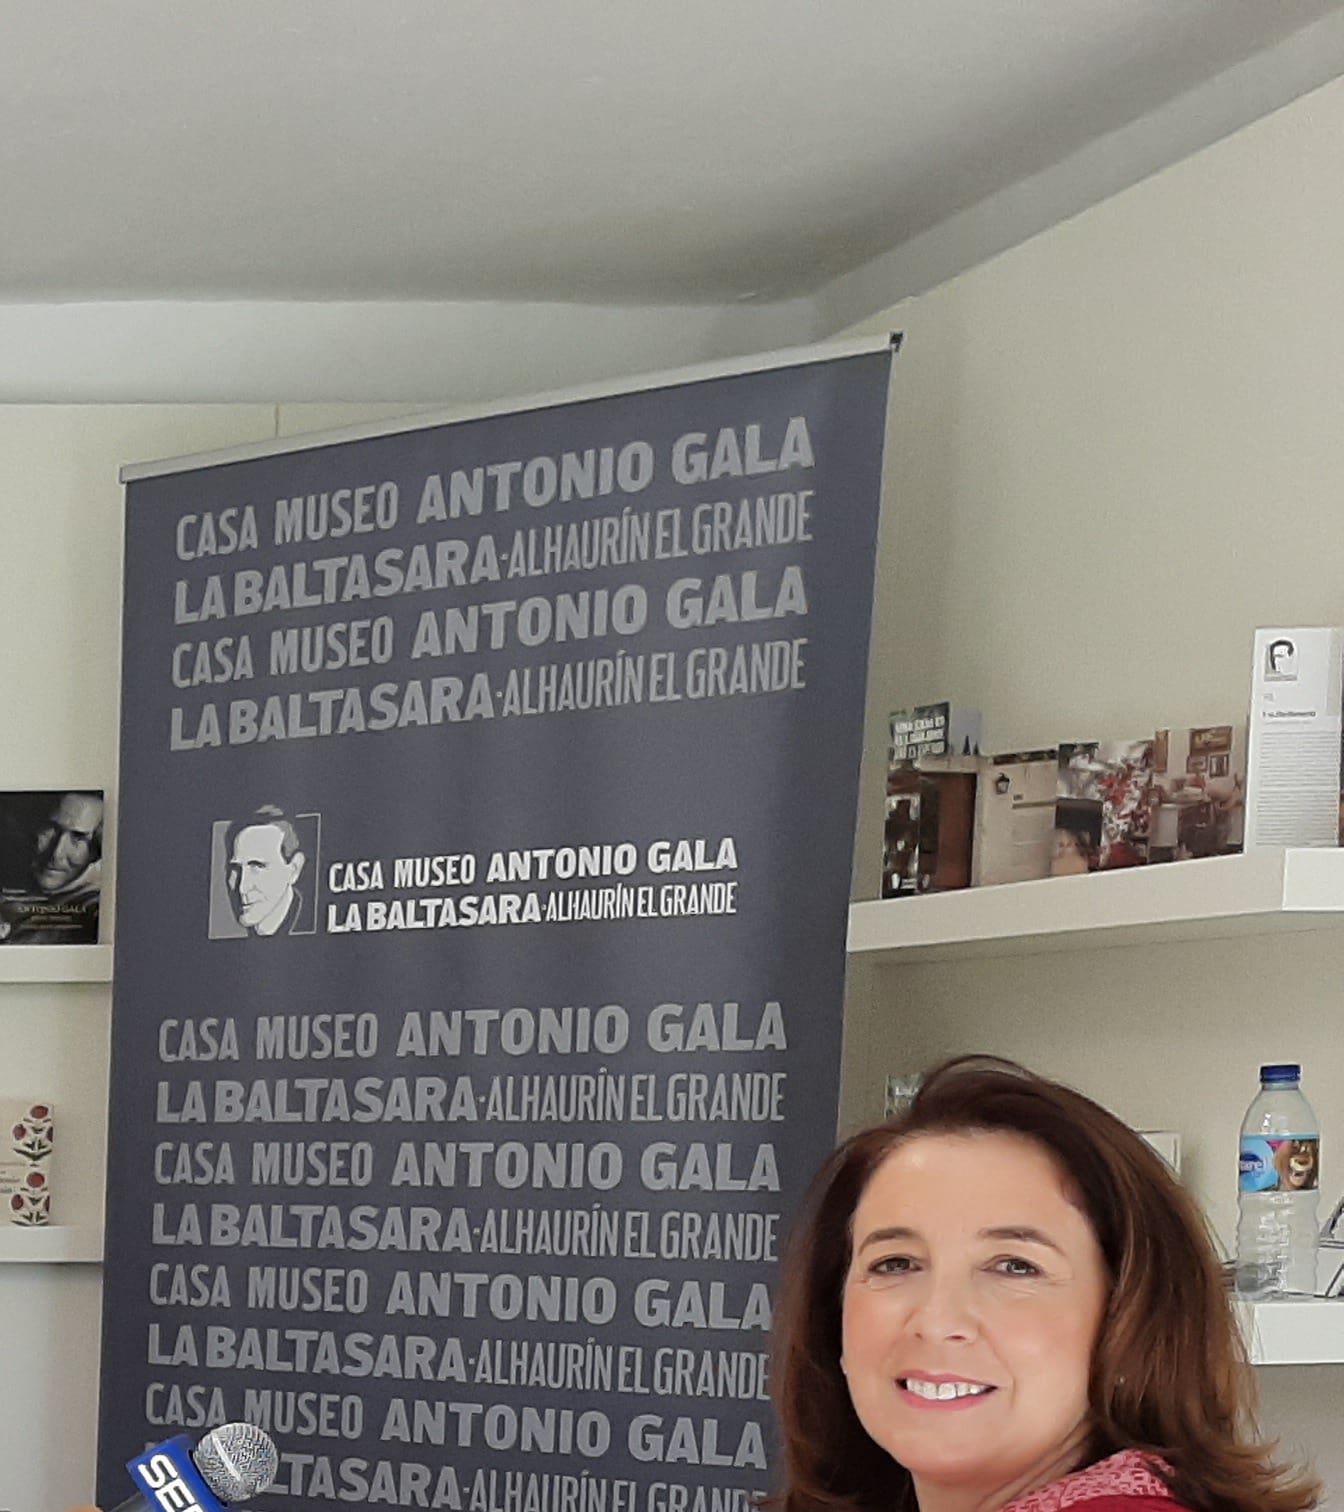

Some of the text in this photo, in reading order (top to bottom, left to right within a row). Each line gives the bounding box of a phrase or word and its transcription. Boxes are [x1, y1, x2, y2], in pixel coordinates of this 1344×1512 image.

[177, 416, 815, 560] CASA MUSEO ANTONIO GALA
[175, 576, 226, 624] LA
[655, 508, 688, 559] EL
[692, 490, 814, 554] GRANDE
[172, 566, 808, 688] CASA MUSEO ANTONIO GALA
[170, 704, 221, 751] LA
[649, 652, 682, 702] EL
[686, 638, 807, 699] GRANDE
[329, 838, 738, 893] CASA MUSEO ANTONIO GALA
[328, 903, 362, 934] LA
[637, 885, 658, 918] EL
[660, 881, 738, 916] GRANDE
[159, 1002, 786, 1062] CASA MUSEO ANTONIO GALA
[157, 1081, 206, 1122] LA
[631, 1074, 662, 1121] EL
[667, 1073, 787, 1121] GRANDE
[155, 1142, 781, 1191] CASA MUSEO ANTONIO GALA
[152, 1203, 202, 1245] LA
[624, 1211, 656, 1257] EL
[660, 1211, 780, 1262] GRANDE
[150, 1263, 772, 1331] CASA MUSEO ANTONIO GALA
[148, 1323, 198, 1366] LA
[618, 1346, 649, 1393] EL
[654, 1348, 772, 1400] GRANDE
[146, 1383, 767, 1470] CASA MUSEO ANTONIO GALA
